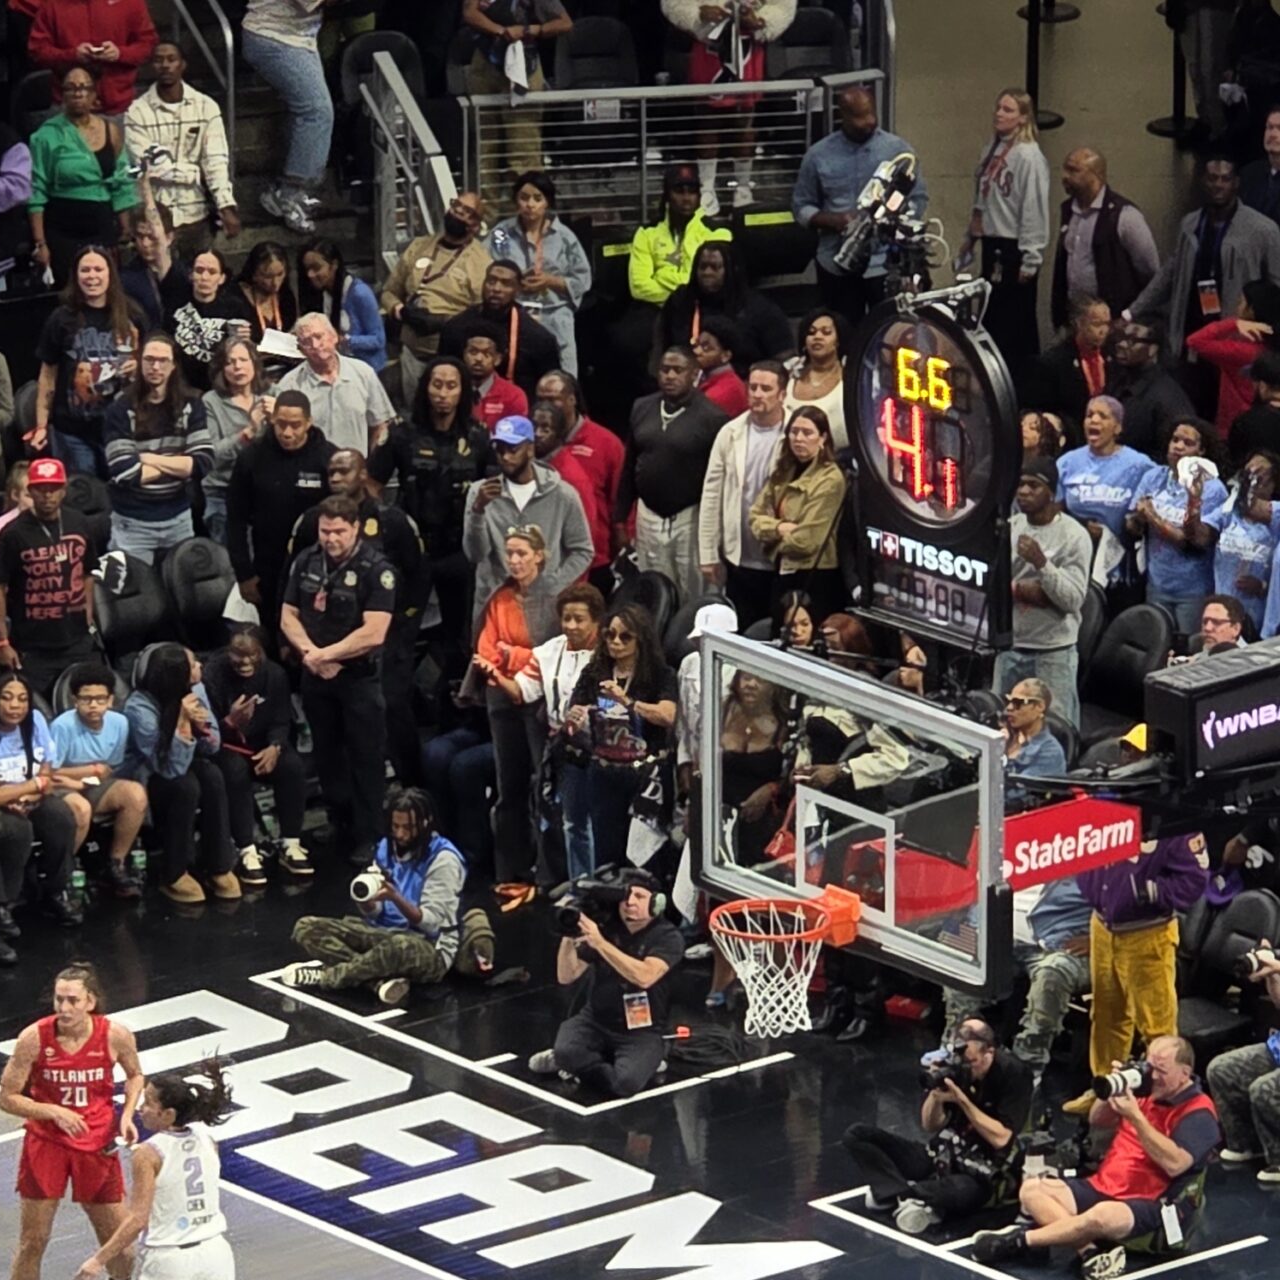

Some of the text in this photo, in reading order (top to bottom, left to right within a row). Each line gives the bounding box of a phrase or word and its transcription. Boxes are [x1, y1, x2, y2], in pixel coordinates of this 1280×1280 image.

[897, 347, 952, 411] 6.6
[878, 397, 957, 509] 4.1
[899, 536, 989, 587] TISSOT
[1215, 703, 1280, 739] WNB
[42, 1067, 104, 1083] ATLANTA
[60, 1086, 89, 1108] 20
[183, 1156, 205, 1197] 2
